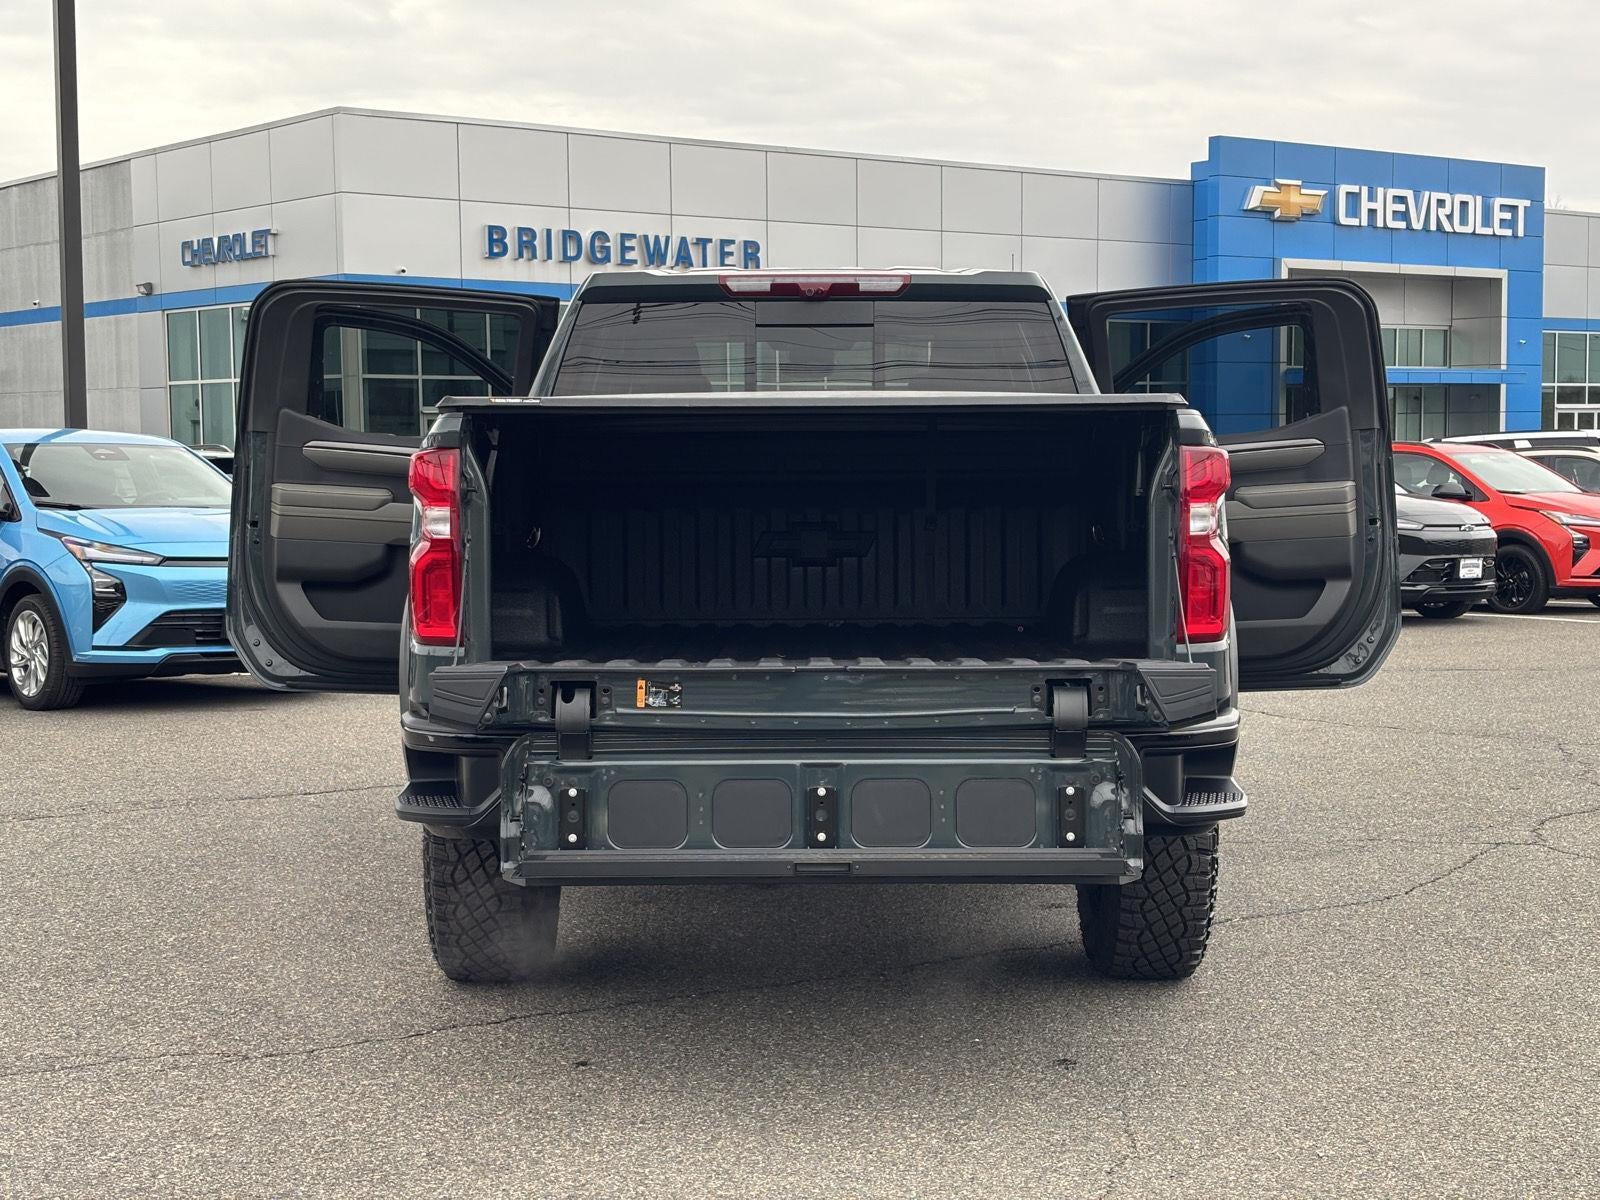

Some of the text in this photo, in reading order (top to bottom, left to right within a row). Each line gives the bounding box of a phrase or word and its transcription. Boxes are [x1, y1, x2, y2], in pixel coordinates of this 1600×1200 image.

[1336, 184, 1530, 237] CHEVROLET
[181, 228, 271, 267] CHEVROLET
[485, 224, 760, 269] BRIDGEWATER
